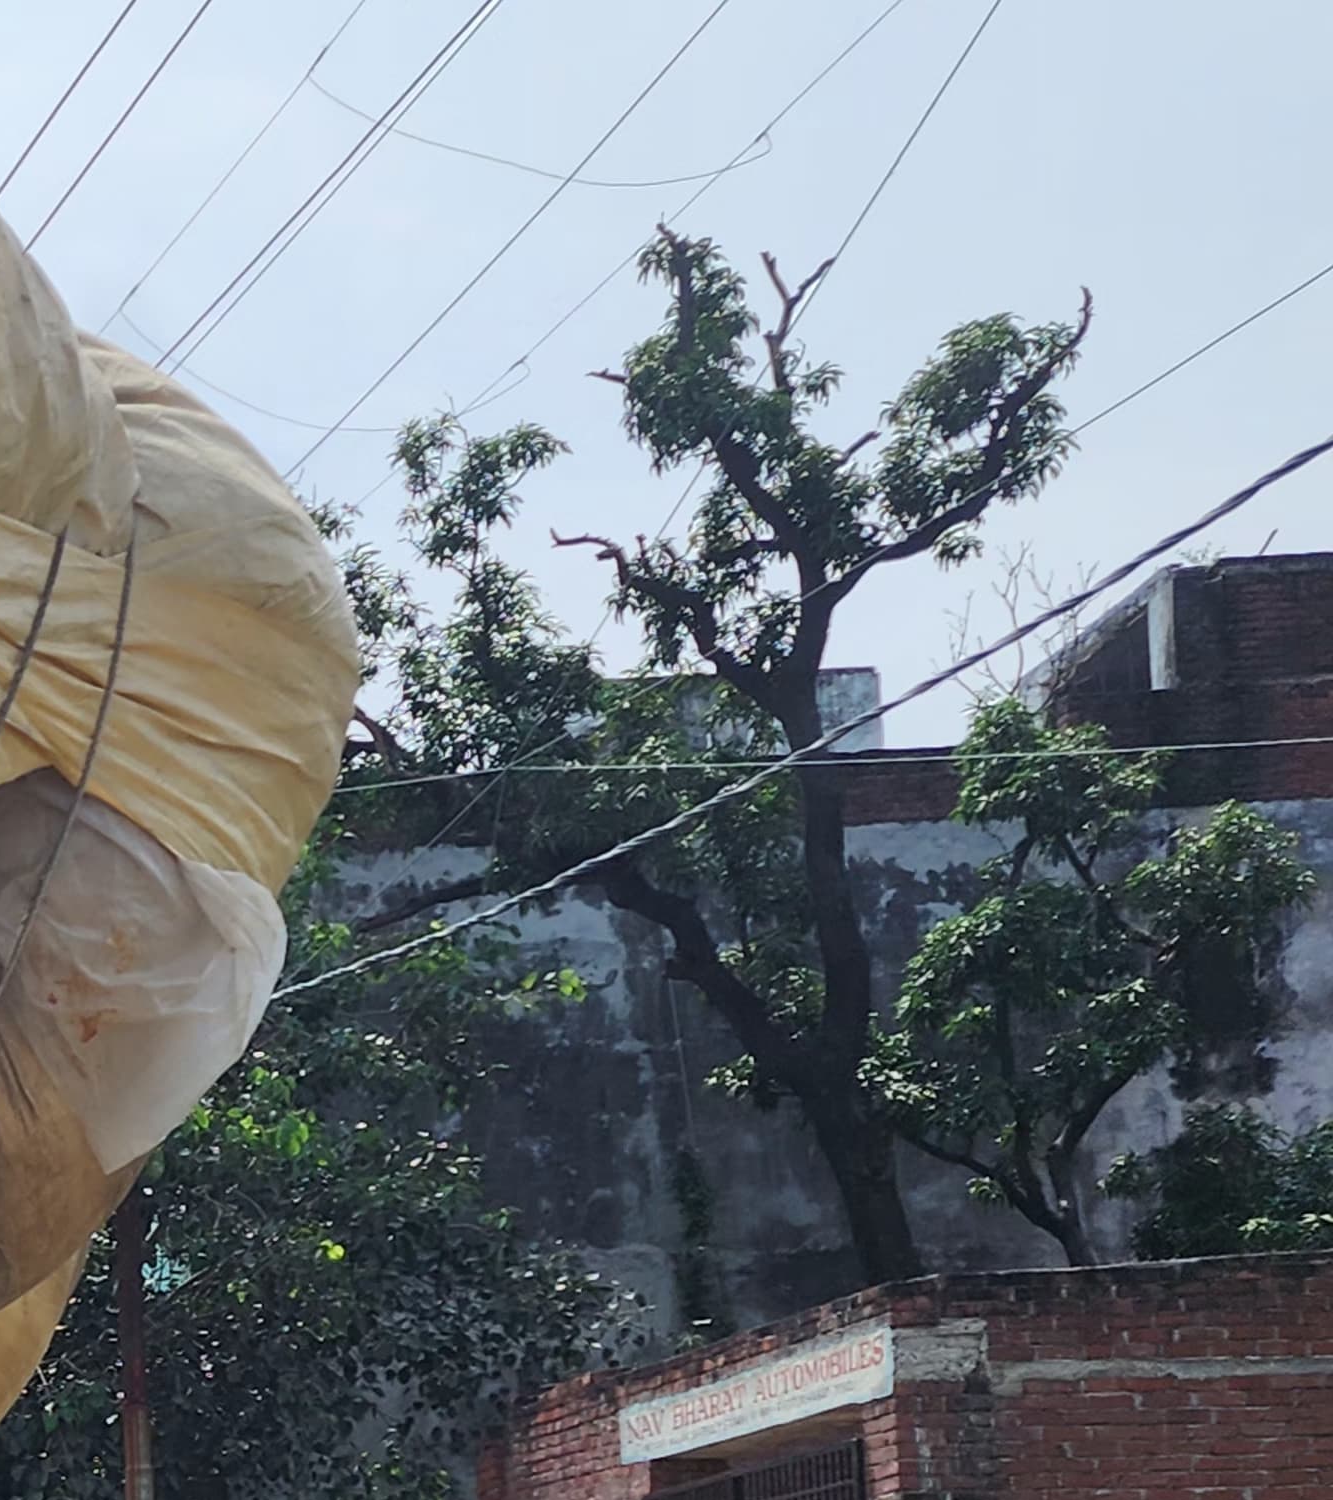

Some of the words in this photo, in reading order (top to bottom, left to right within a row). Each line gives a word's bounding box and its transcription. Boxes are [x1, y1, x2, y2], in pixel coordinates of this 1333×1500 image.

[628, 1408, 665, 1441] NAV
[672, 1383, 747, 1430] BHARAT
[754, 1335, 885, 1403] AUTOMOBILES
